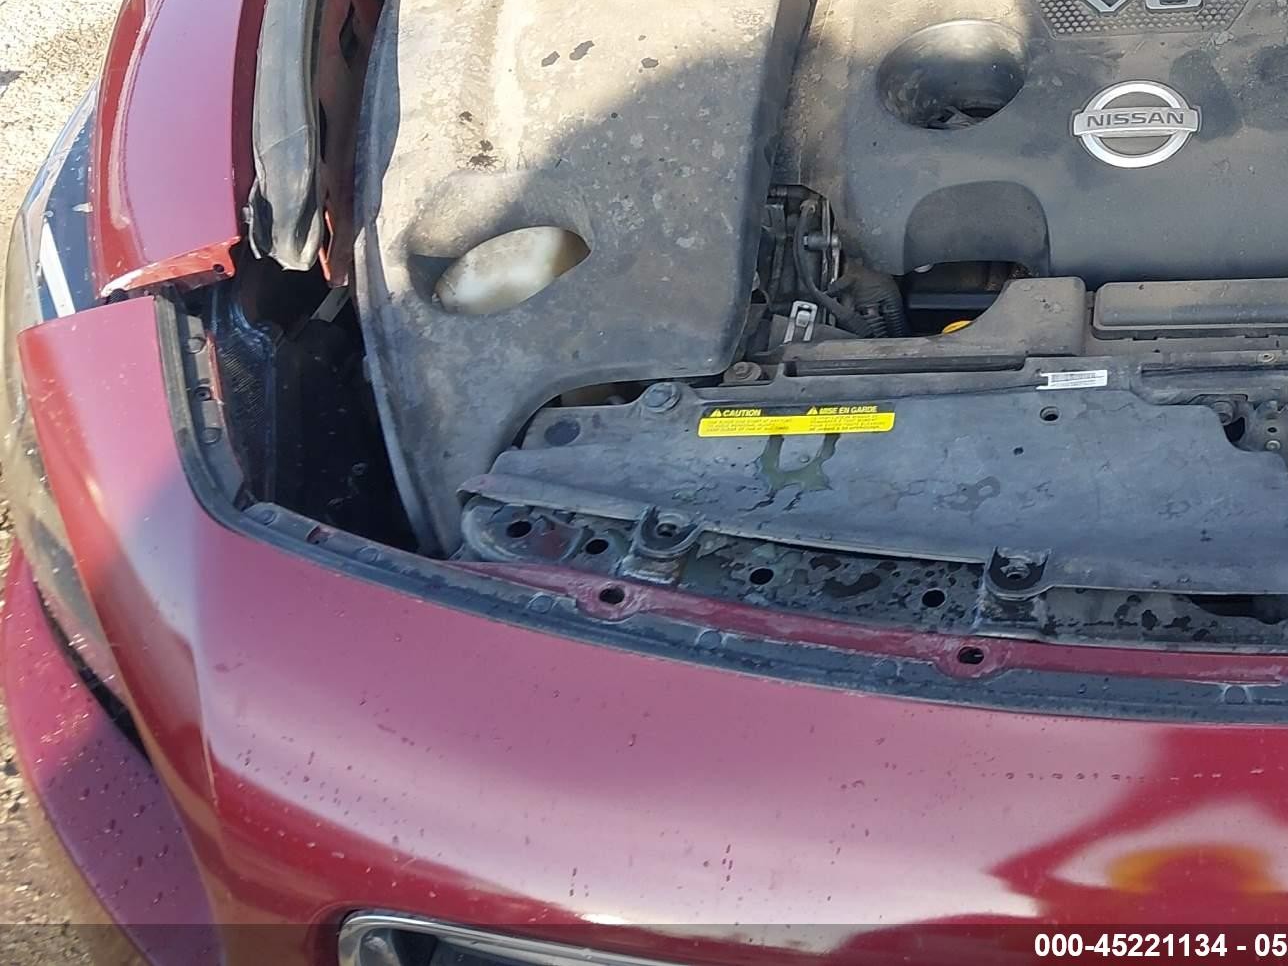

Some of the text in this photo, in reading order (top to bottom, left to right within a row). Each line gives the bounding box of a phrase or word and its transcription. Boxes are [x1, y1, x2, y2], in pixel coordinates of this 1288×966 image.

[1087, 112, 1184, 127] NISSAN
[722, 408, 762, 418] CAUTION
[819, 405, 878, 415] MISE EN GARDE
